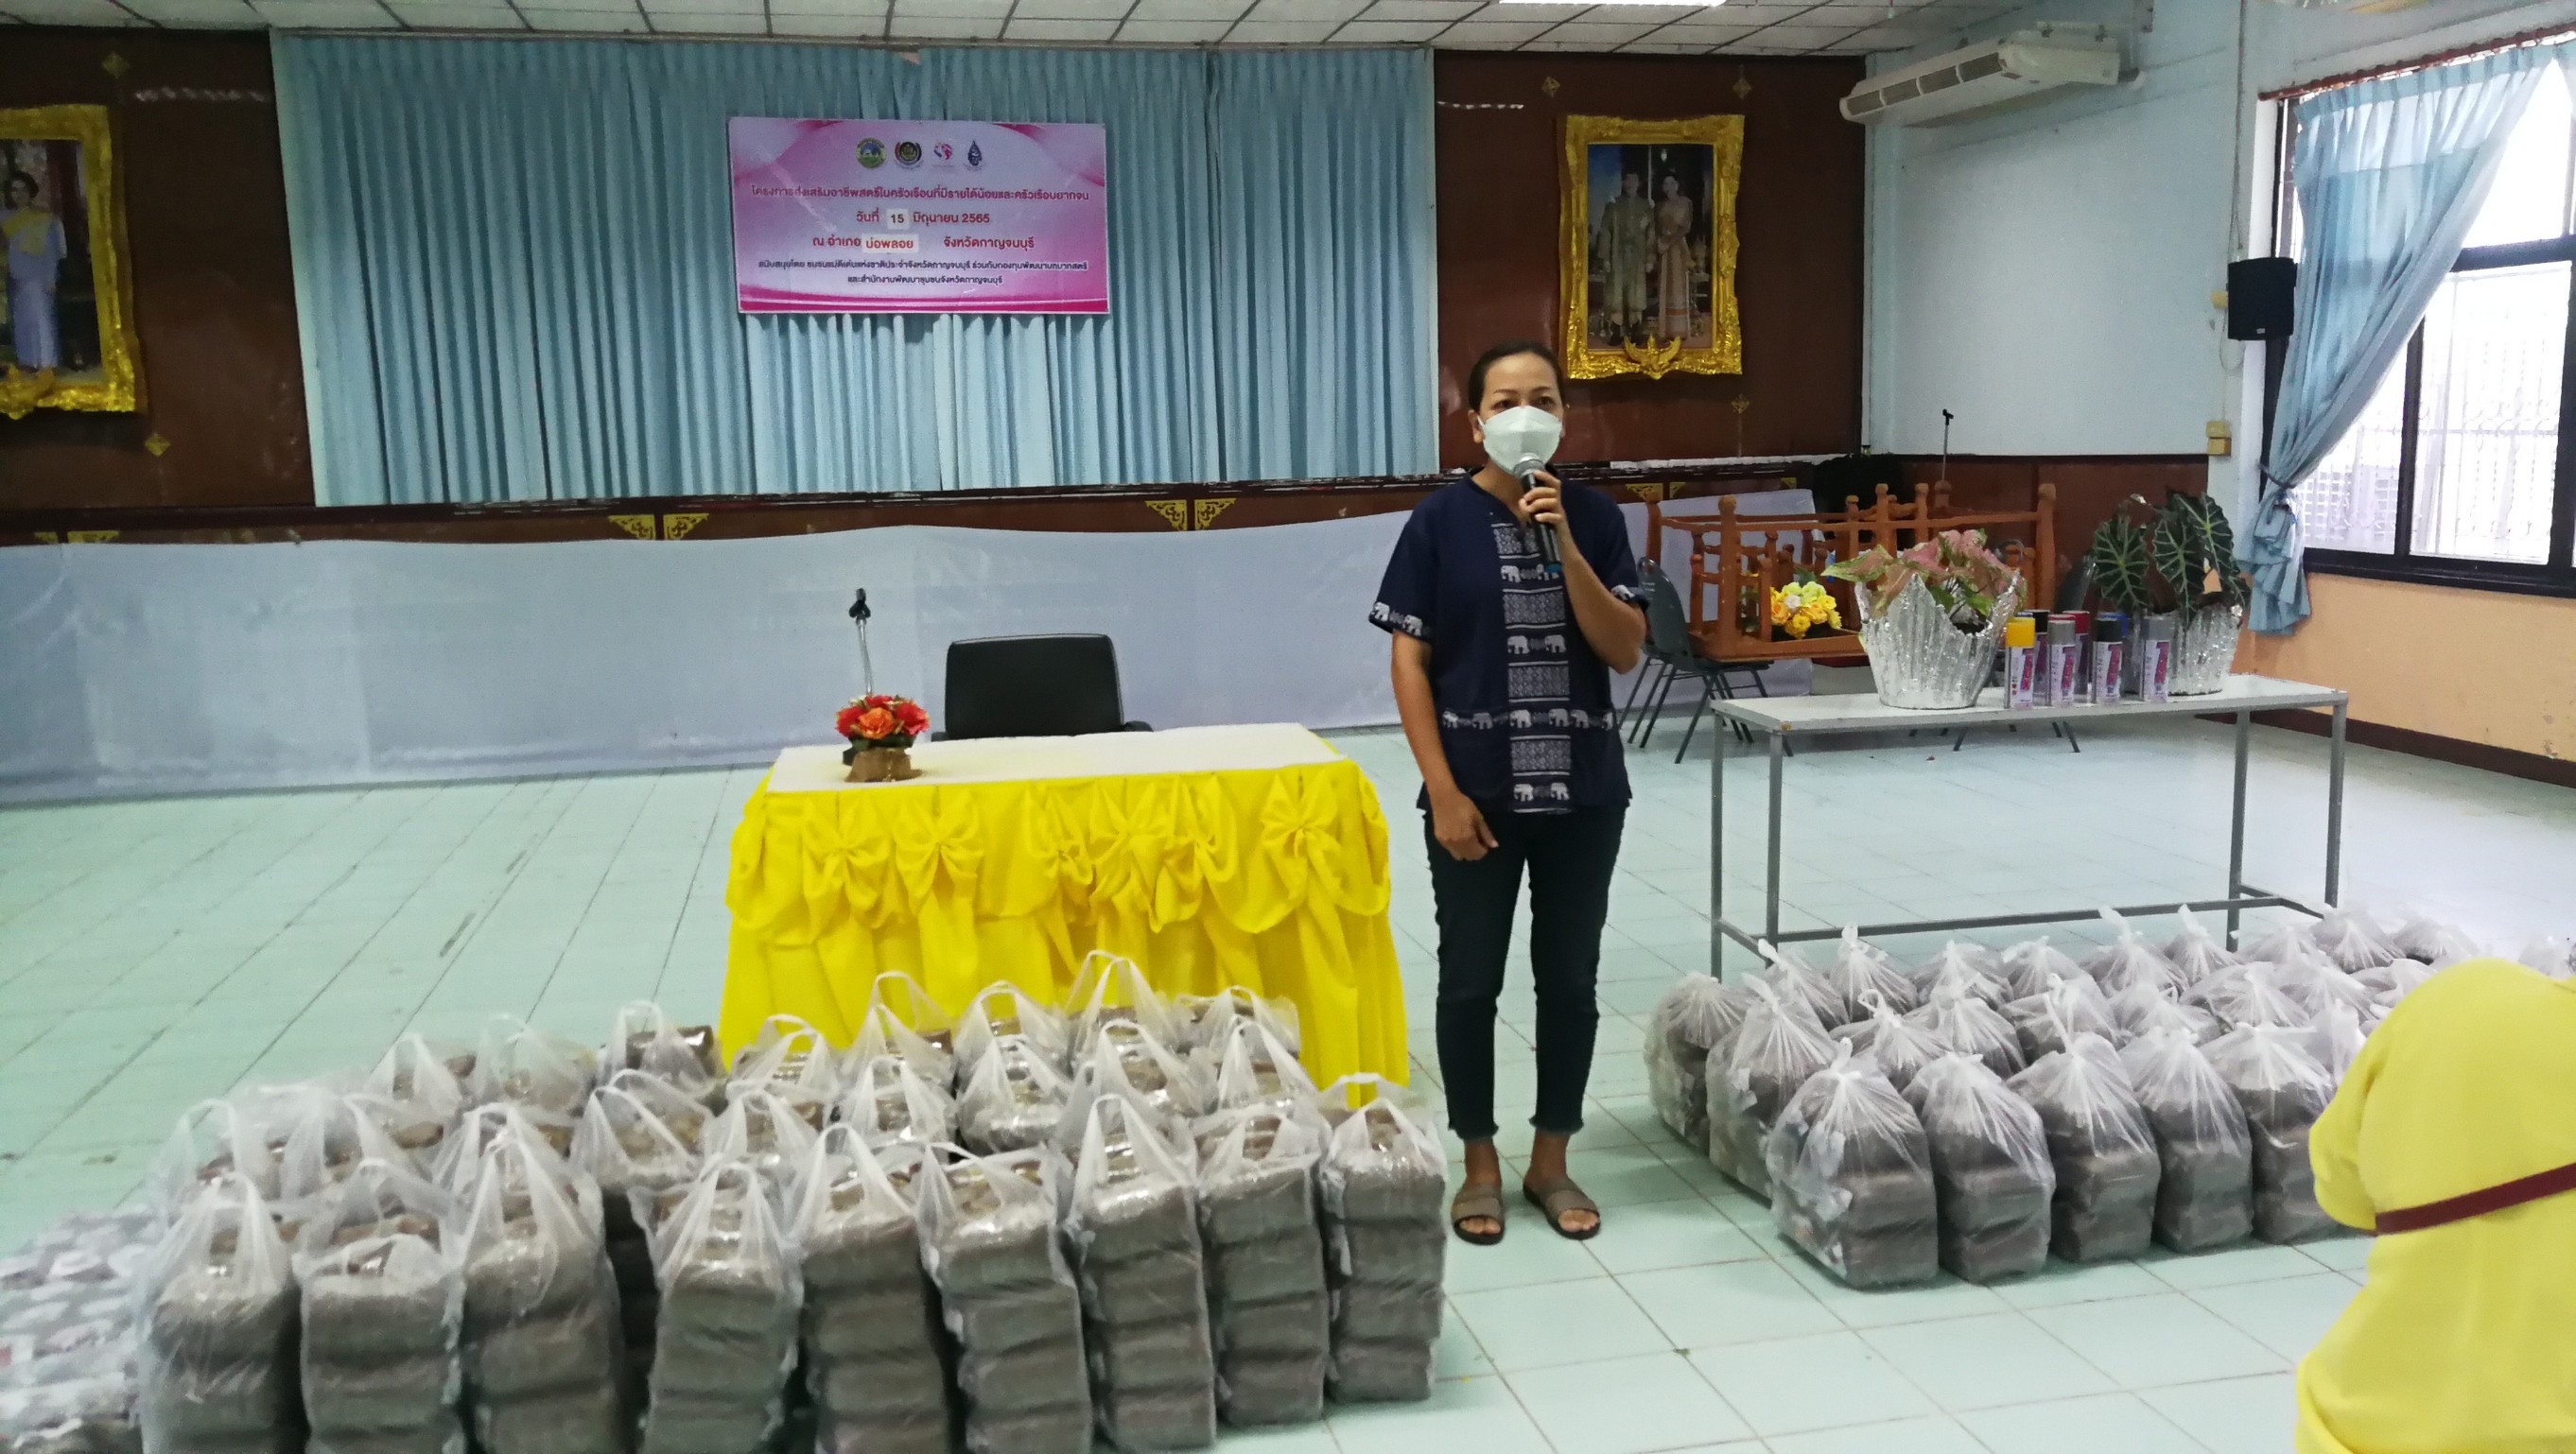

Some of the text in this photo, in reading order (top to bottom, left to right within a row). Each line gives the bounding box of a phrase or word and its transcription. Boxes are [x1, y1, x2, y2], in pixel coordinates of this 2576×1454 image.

[856, 207, 990, 227] วันที่ 15 มิถุนายน 2565
[812, 237, 825, 246] ณ
[865, 238, 914, 249] บ่อพลอย
[944, 235, 1036, 251] จังหวัดกาญจนบุรี
